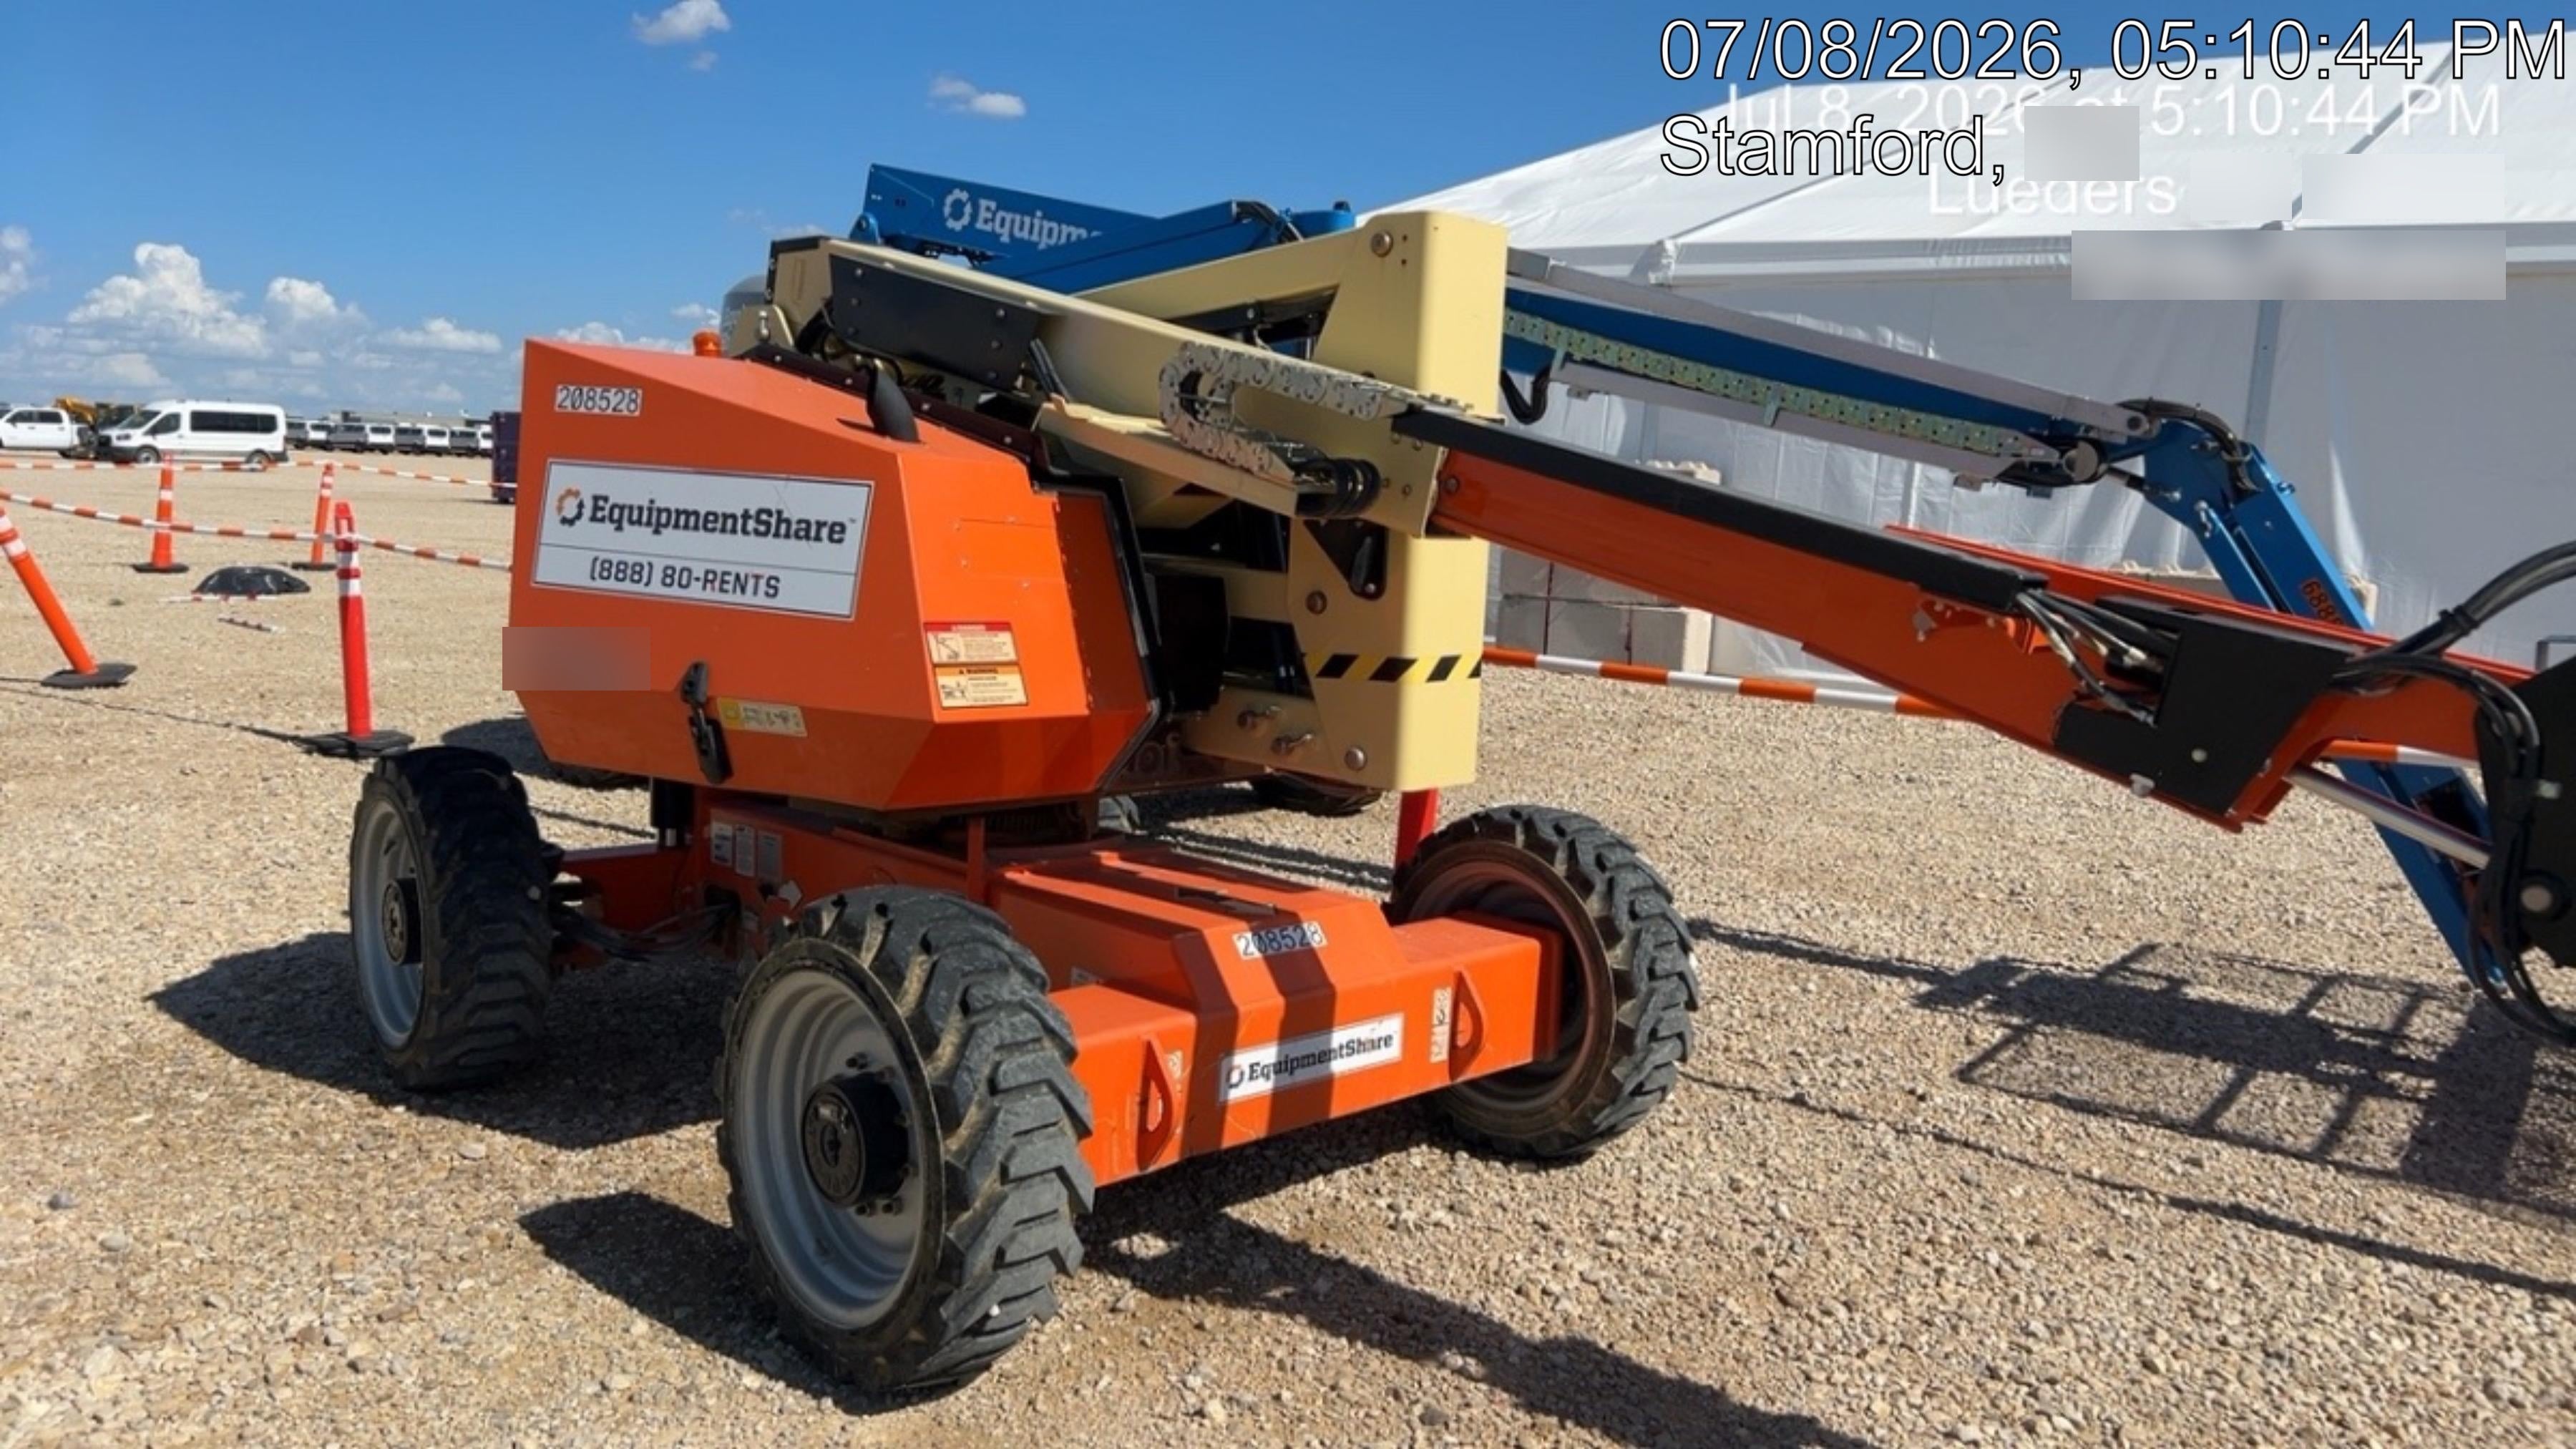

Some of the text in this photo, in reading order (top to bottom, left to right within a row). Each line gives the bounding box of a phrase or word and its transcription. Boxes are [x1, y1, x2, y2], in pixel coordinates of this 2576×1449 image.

[557, 386, 639, 413] 208528
[590, 556, 781, 598] (888) 80-RENTS
[2301, 579, 2345, 624] 688
[1236, 922, 1324, 957] 208528
[1248, 1033, 1394, 1082] EquipmentShare
